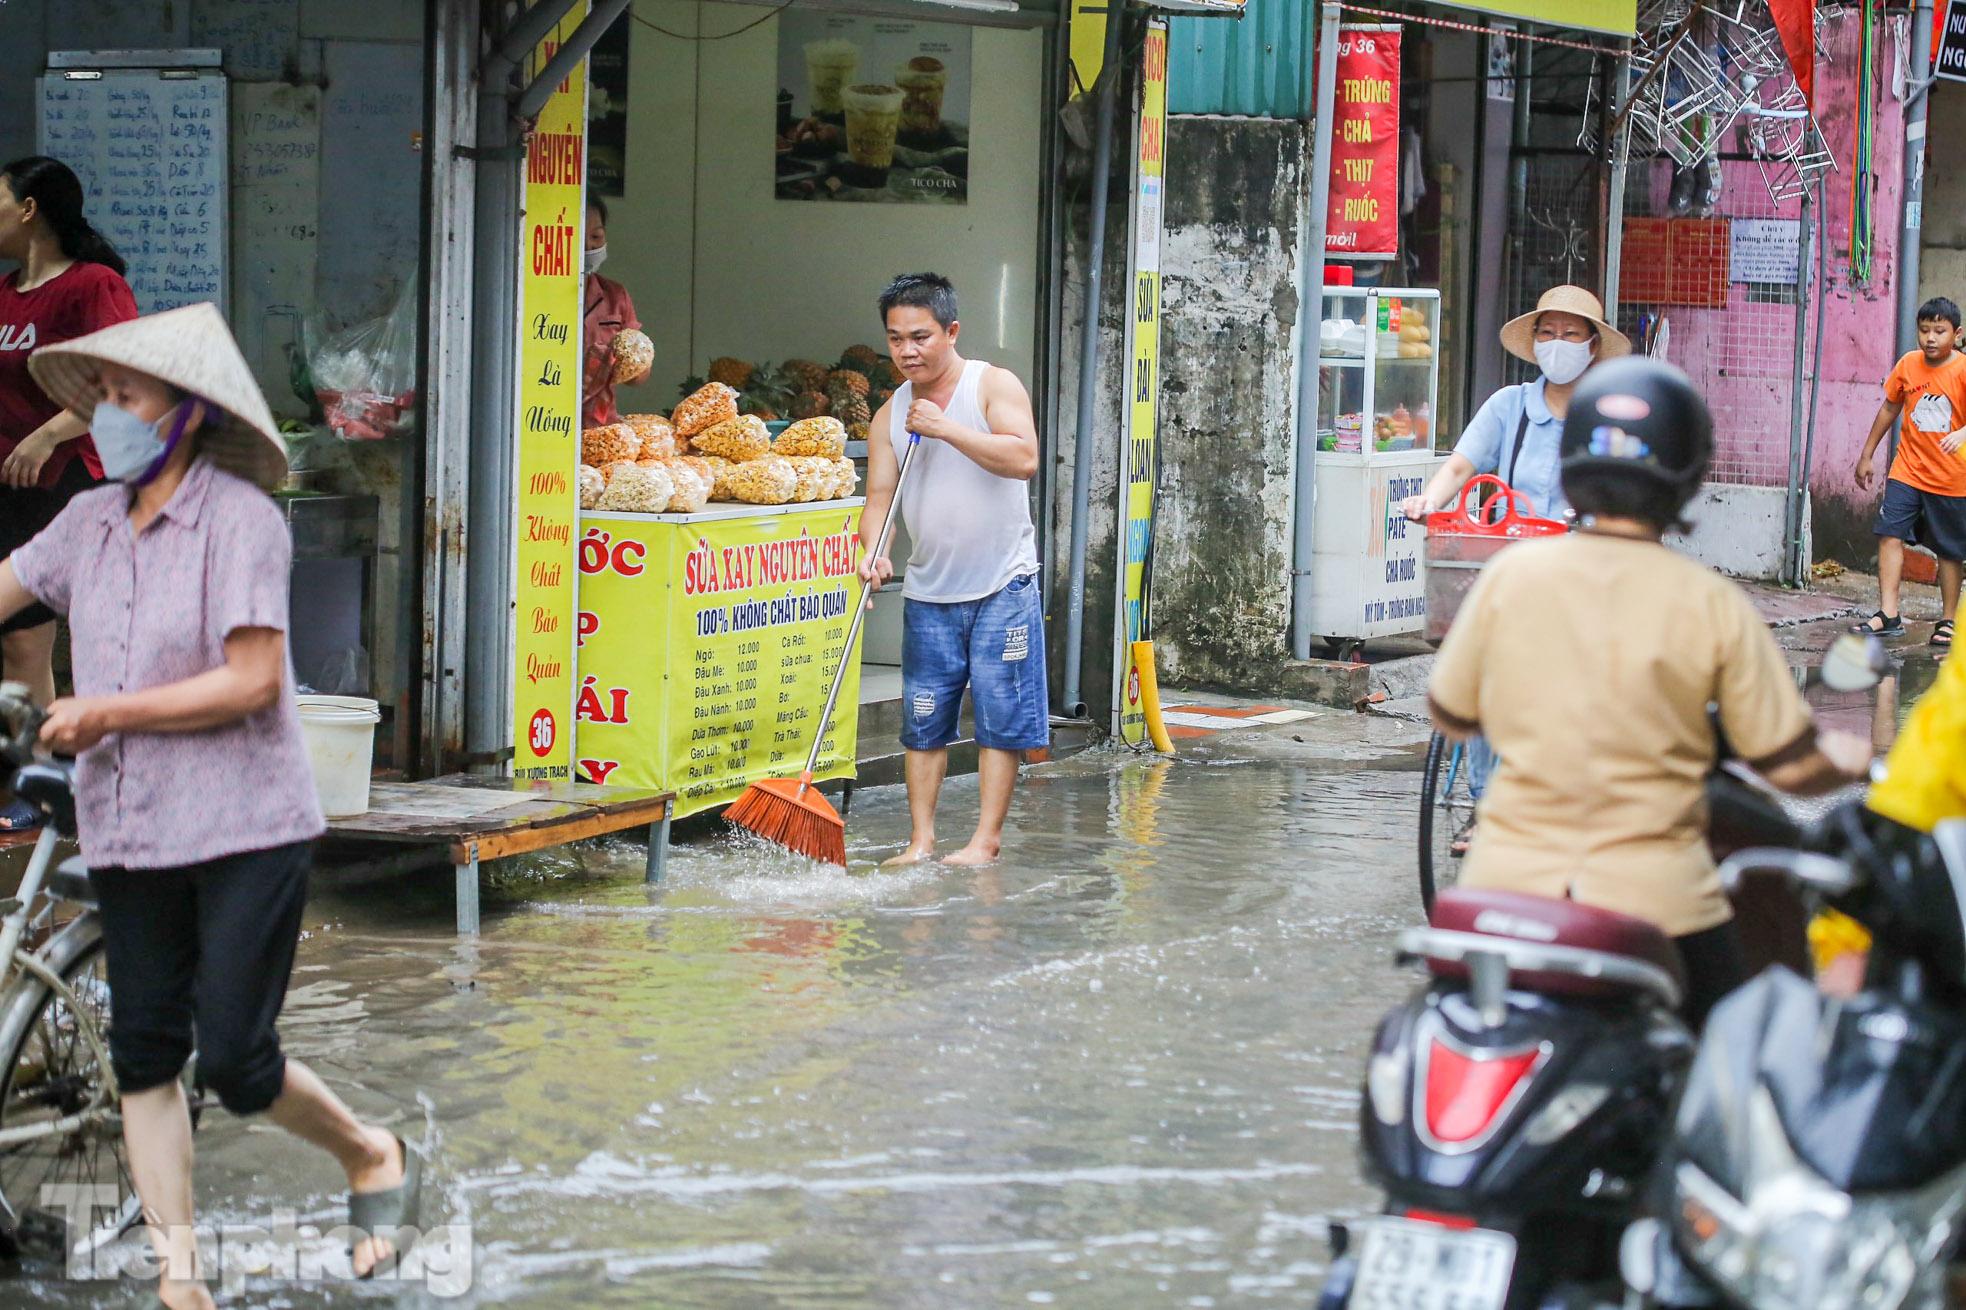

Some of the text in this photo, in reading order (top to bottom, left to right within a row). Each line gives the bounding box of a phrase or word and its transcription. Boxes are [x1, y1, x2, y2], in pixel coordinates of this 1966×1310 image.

[1355, 39, 1375, 55] 36
[1344, 75, 1391, 104] TRỨNG
[1141, 115, 1160, 162] CHA
[1344, 112, 1372, 144] CHẢ
[528, 123, 583, 185] NGUYÊN
[1344, 159, 1374, 187] THỊT
[1344, 190, 1379, 223] RUỐC
[533, 207, 573, 276] CHẤT
[533, 313, 568, 345] Xay
[538, 359, 561, 386] Là
[525, 405, 571, 438] Uống
[1130, 439, 1151, 483] LOAN
[529, 471, 566, 495] 100%
[524, 515, 569, 546] Không
[685, 515, 860, 595] SỮA XAY NGUYÊN CHẤT
[530, 560, 561, 588] Chất
[531, 607, 559, 634] Bảo
[696, 583, 848, 636] 100% KHÔNG CHẤT BẢO QUẢN
[737, 641, 760, 656] 12.000
[526, 653, 561, 685] Quản
[737, 660, 758, 673] 10.000
[711, 684, 732, 696] Xanh:
[736, 678, 757, 692] 10.000
[1129, 673, 1139, 699] 36
[735, 698, 757, 712] 10.000
[532, 717, 552, 749] 36
[733, 720, 754, 733] 10.000
[688, 766, 703, 780] Rau
